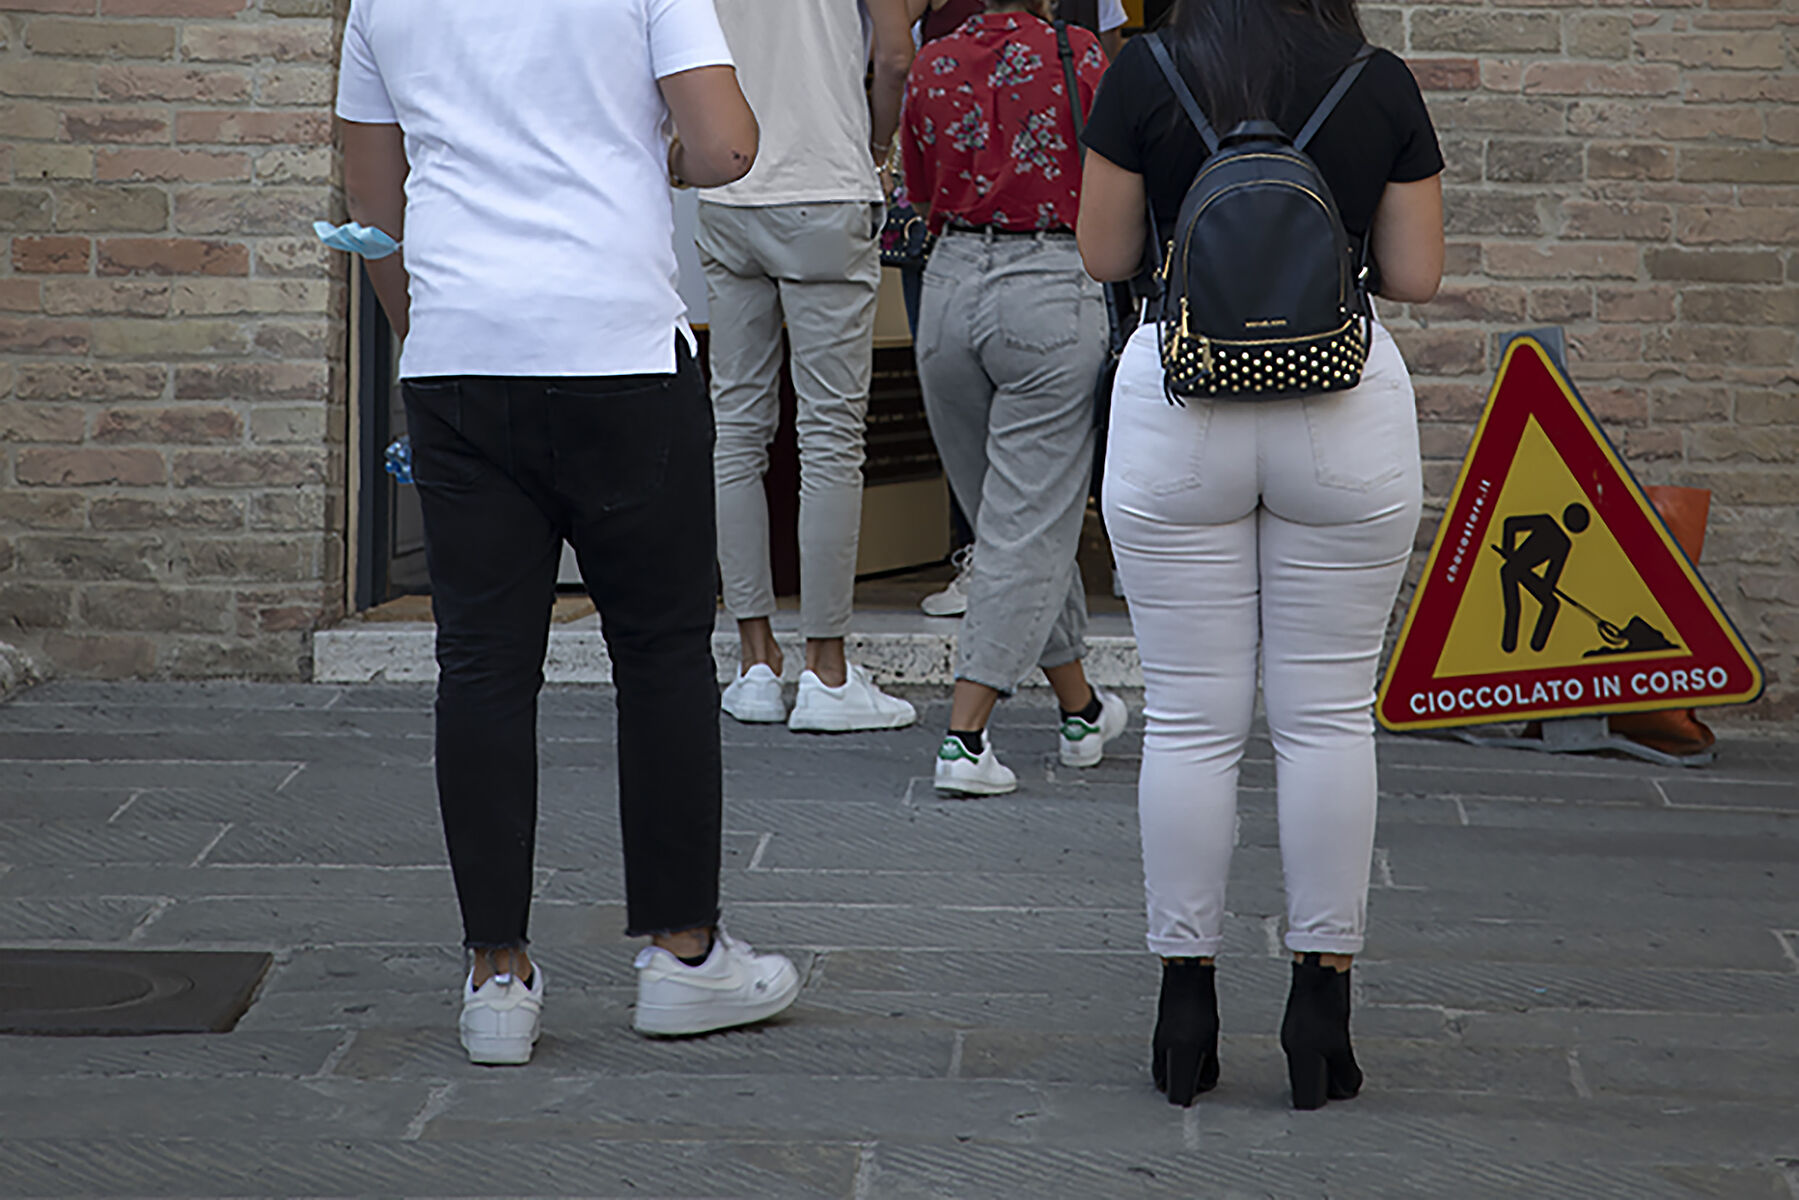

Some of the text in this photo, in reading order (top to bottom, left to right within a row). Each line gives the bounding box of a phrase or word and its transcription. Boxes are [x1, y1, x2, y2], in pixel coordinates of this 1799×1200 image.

[1408, 666, 1729, 714] CIOCCOLATO IN CORSO
